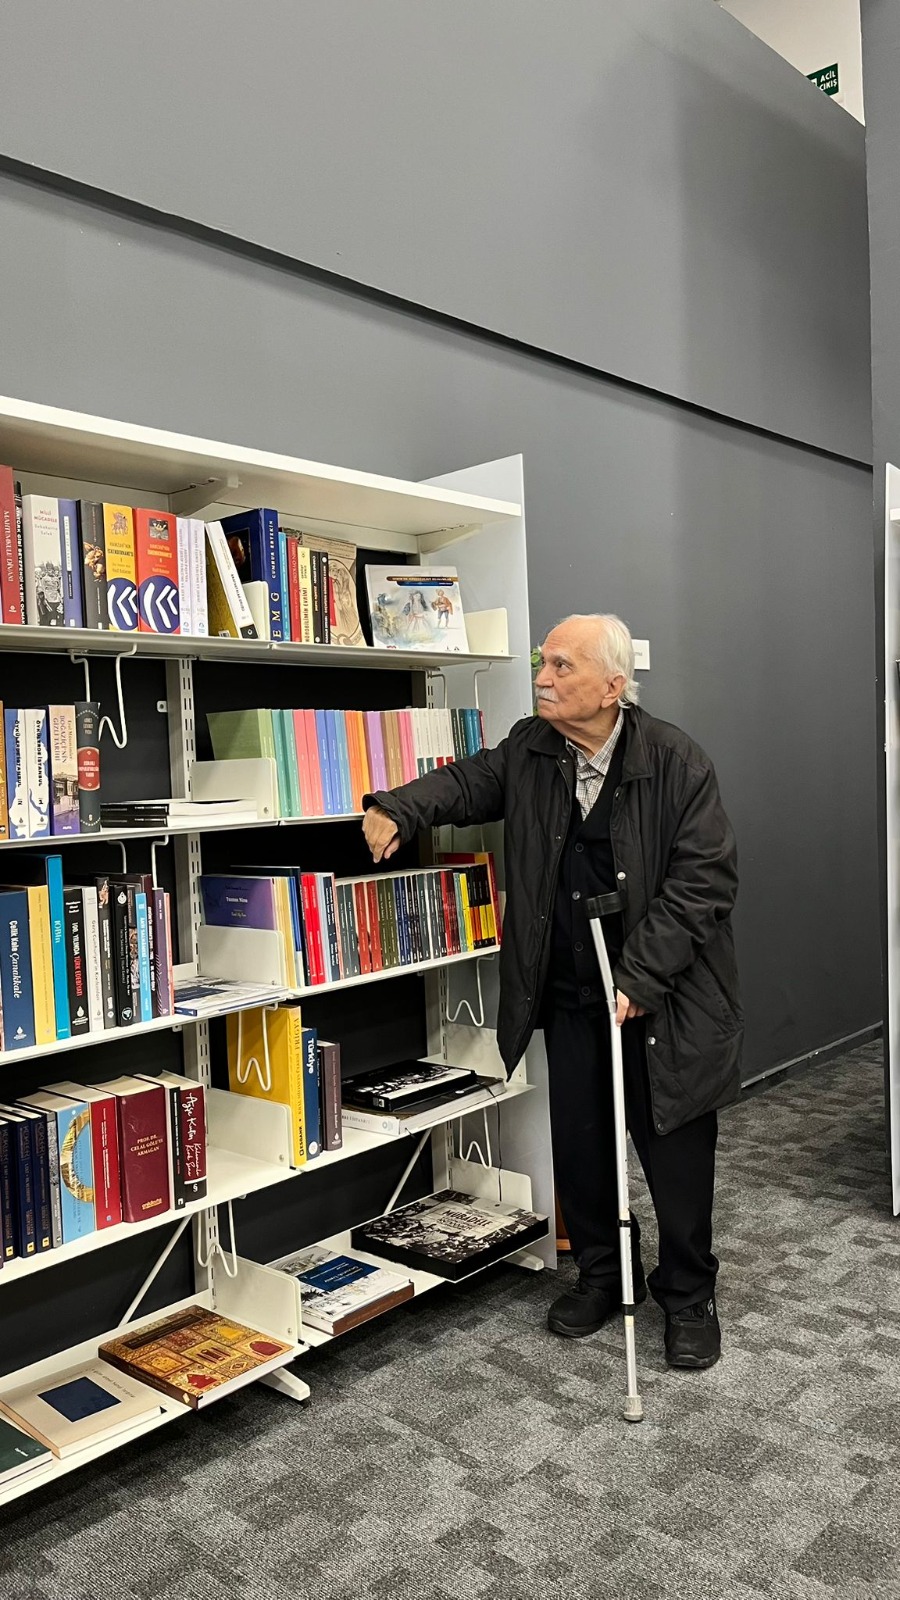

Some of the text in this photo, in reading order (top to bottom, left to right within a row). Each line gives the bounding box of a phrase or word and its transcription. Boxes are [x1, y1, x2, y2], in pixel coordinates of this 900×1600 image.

[9, 920, 22, 998] Çelik Kale Çanakkale
[73, 956, 82, 970] TÜRK
[74, 971, 83, 996] EDEBİYATI
[307, 1038, 316, 1074] Türkiye
[181, 1092, 198, 1141] Ayşe Kulin
[130, 1143, 146, 1152] CELAL
